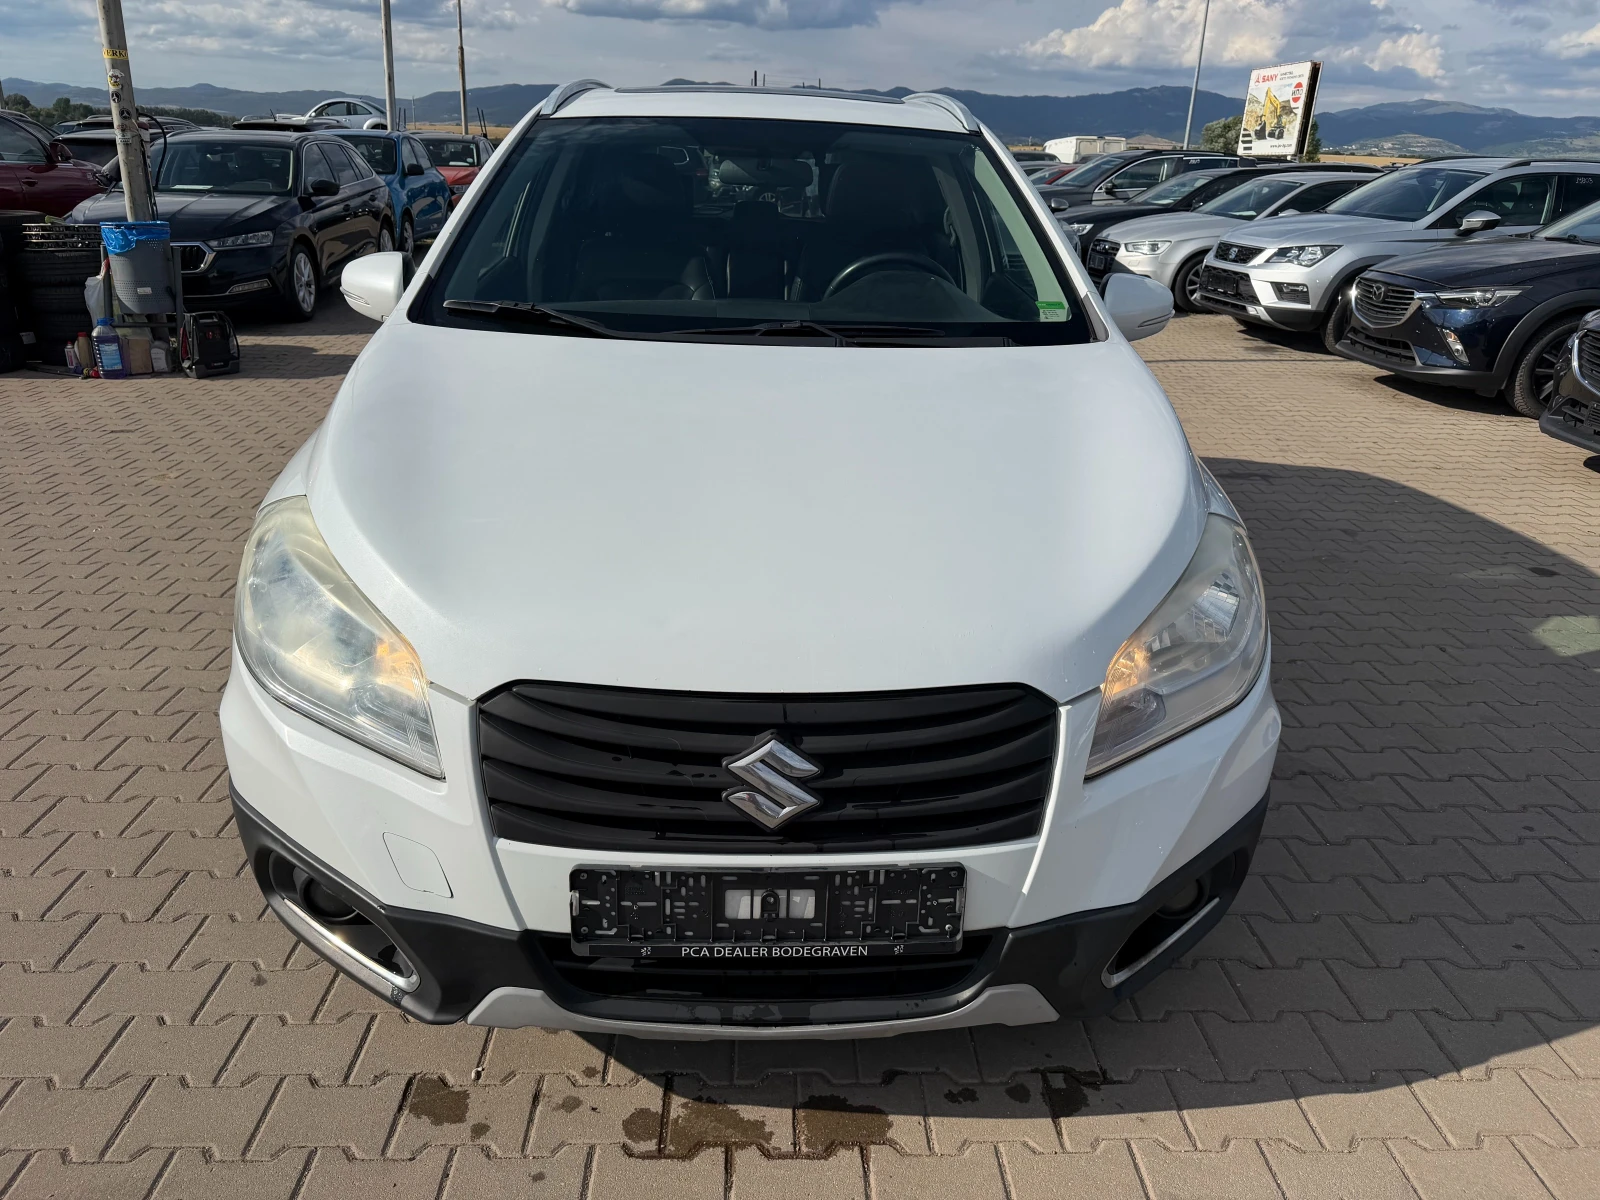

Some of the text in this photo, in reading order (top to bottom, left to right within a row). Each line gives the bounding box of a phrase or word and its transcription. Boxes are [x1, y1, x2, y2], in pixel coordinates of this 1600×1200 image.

[104, 49, 128, 58] ERK
[1262, 74, 1278, 83] SANY
[681, 946, 869, 957] PCA DEALER BODEGRAVEN
